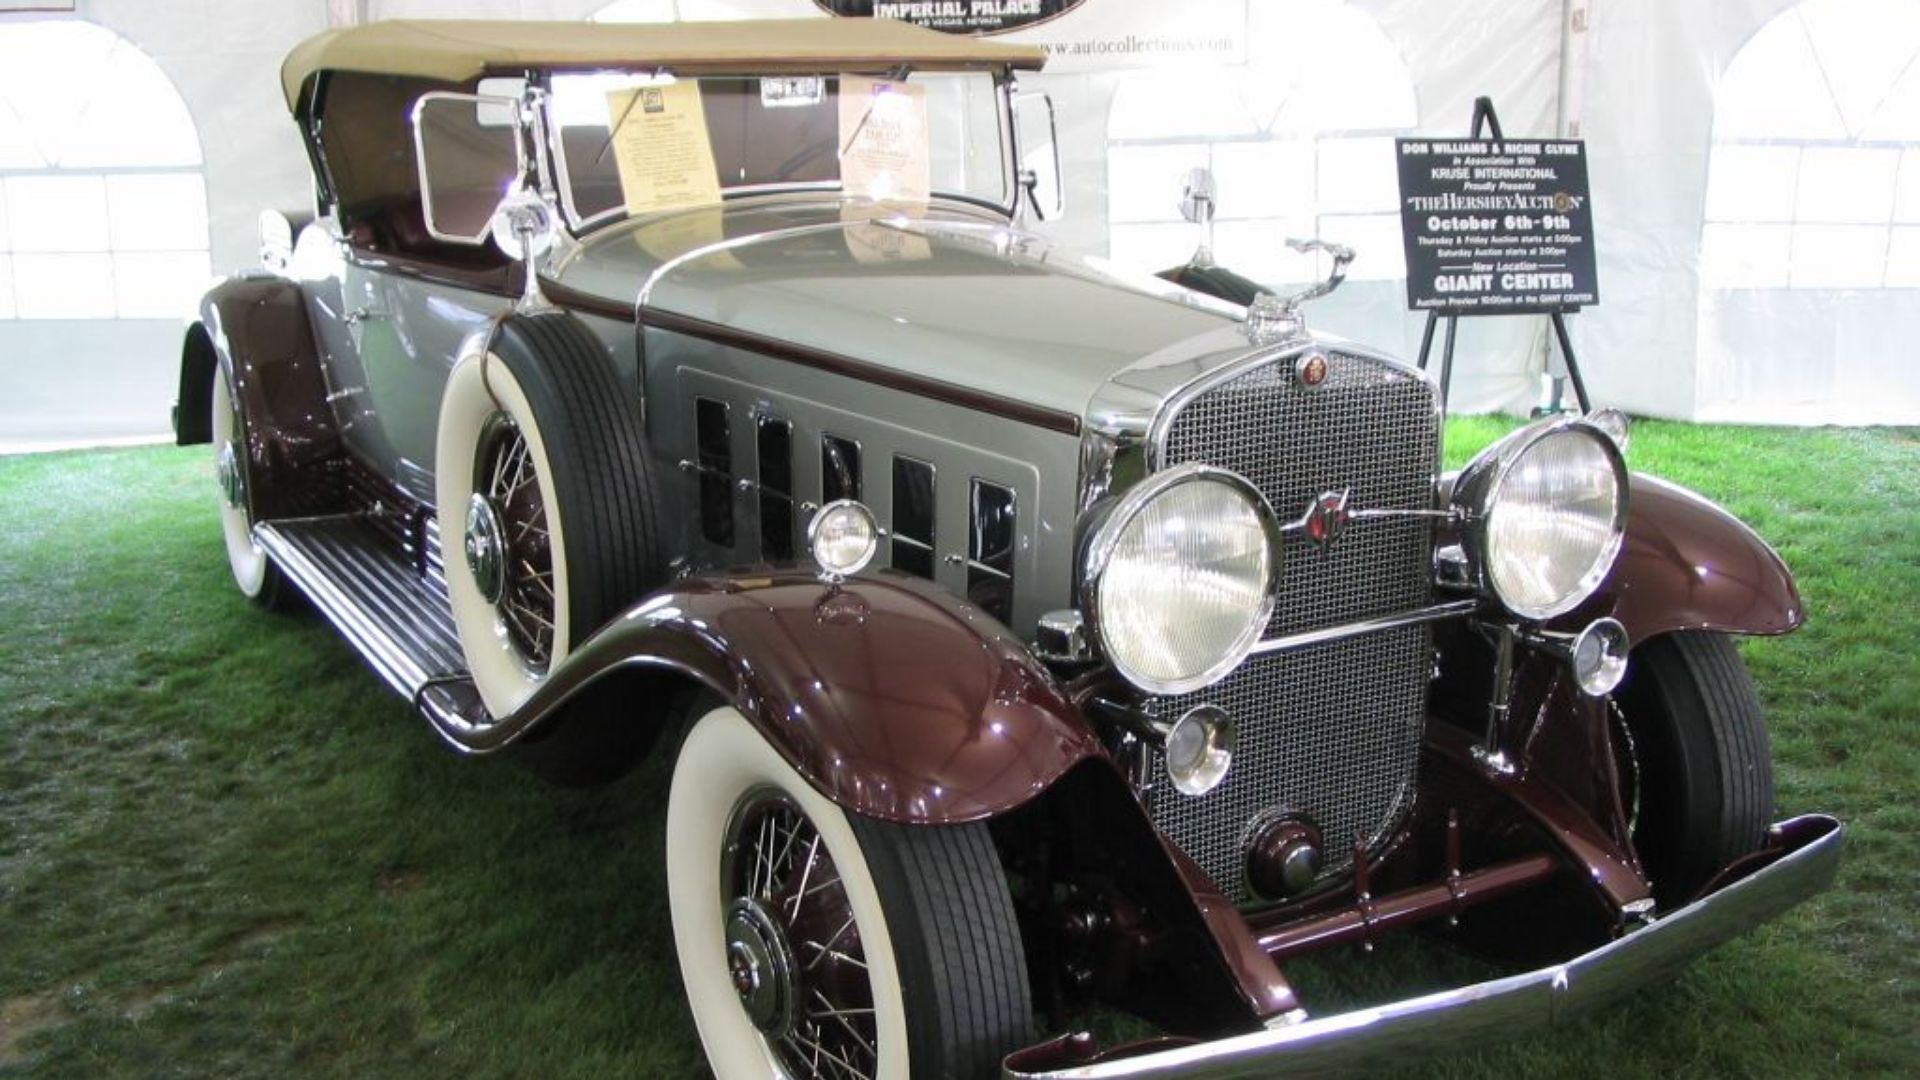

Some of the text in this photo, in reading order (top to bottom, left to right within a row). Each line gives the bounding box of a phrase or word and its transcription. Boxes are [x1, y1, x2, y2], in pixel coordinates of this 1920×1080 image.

[873, 0, 1042, 18] IMPERIAL PALACE
[967, 17, 1002, 25] NEVADA
[1039, 35, 1234, 55] ww.autocollections.com
[1402, 144, 1579, 154] DON WILLIAMS & RICHIE CLYNE
[1464, 156, 1514, 165] Association
[1517, 156, 1536, 165] With
[1431, 168, 1557, 179] KRUSE INTERNATIONAL
[1463, 182, 1536, 193] Proudly Presents
[1427, 216, 1497, 231] October
[1418, 236, 1453, 246] Thursday
[1465, 236, 1488, 245] Friday
[1491, 235, 1519, 244] Auction
[1521, 235, 1542, 243] starts
[1438, 248, 1472, 258] Saturday
[1475, 248, 1502, 257] Auction
[1505, 248, 1526, 256] starts
[1471, 261, 1538, 272] New Location
[1434, 273, 1574, 292] GIANT CENTER
[1416, 298, 1446, 307] Auction
[1449, 297, 1478, 306] Preview
[1539, 294, 1562, 303] GIANT
[1564, 293, 1592, 302] CENTER
